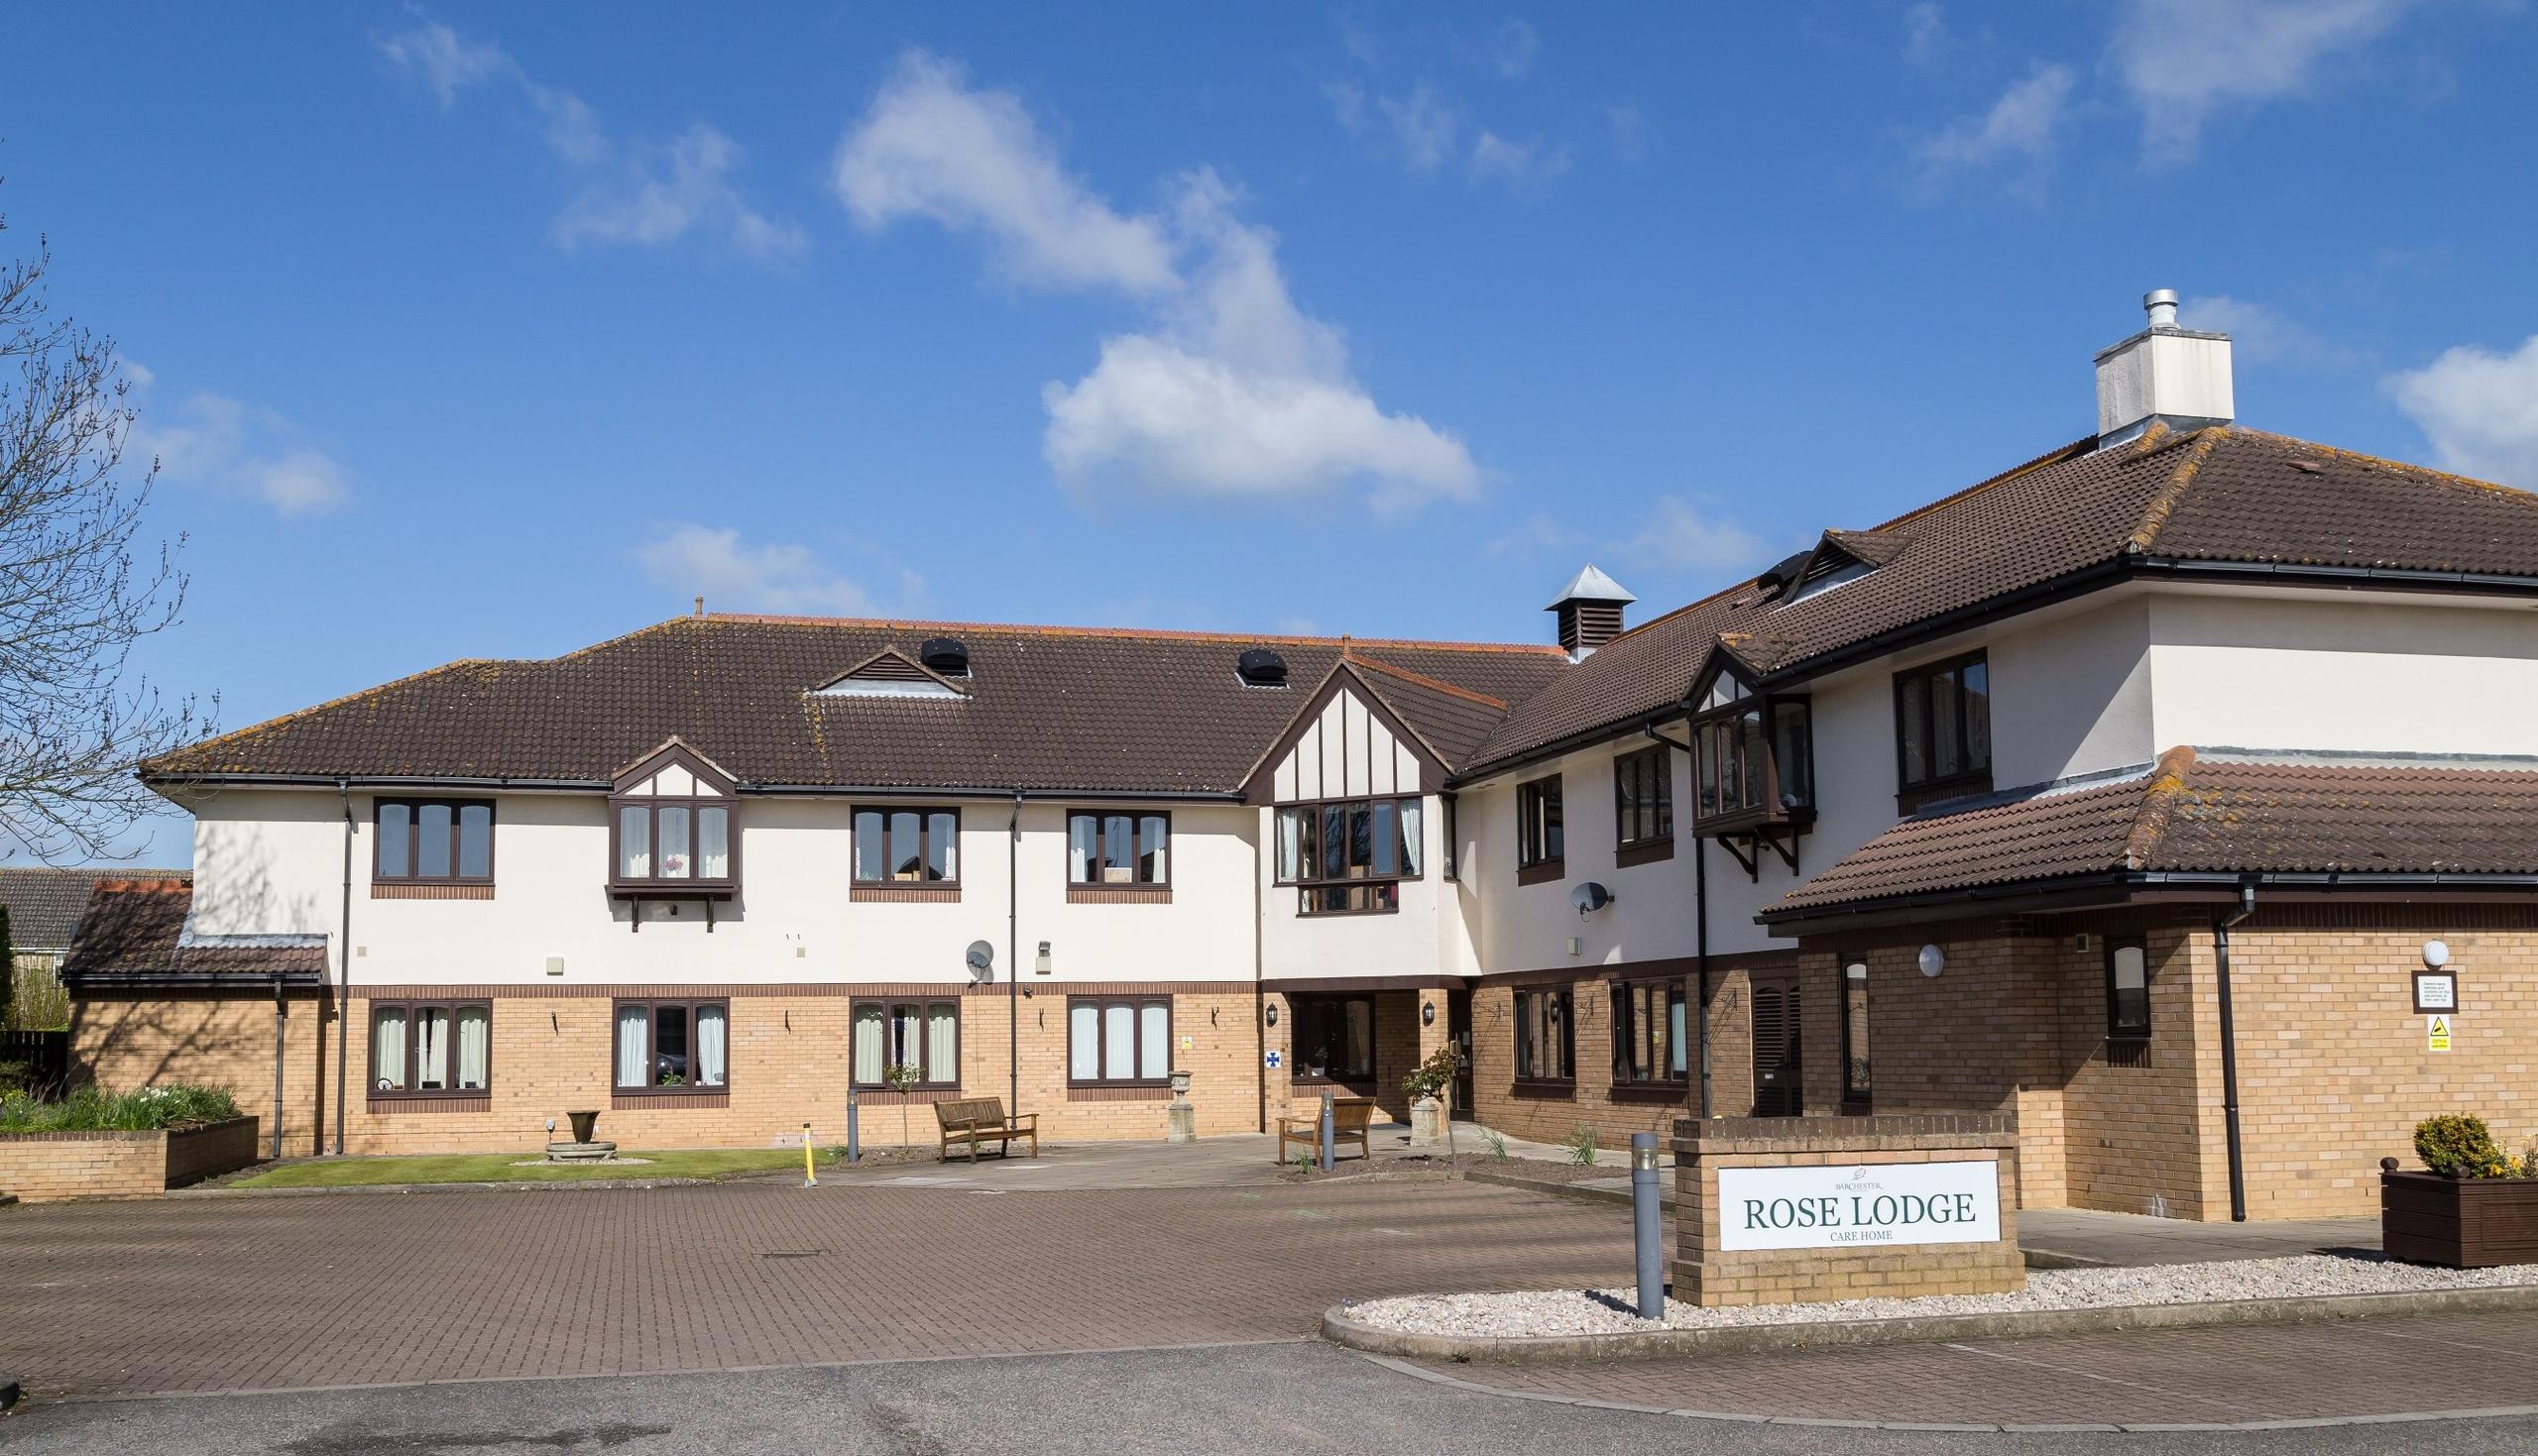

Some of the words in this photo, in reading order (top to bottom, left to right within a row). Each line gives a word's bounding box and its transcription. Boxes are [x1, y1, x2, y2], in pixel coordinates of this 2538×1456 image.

[1744, 1197, 1840, 1229] ROSE
[1851, 1194, 1975, 1225] LODGE
[1831, 1232, 1858, 1241] CARE
[1861, 1231, 1892, 1240] HOME
